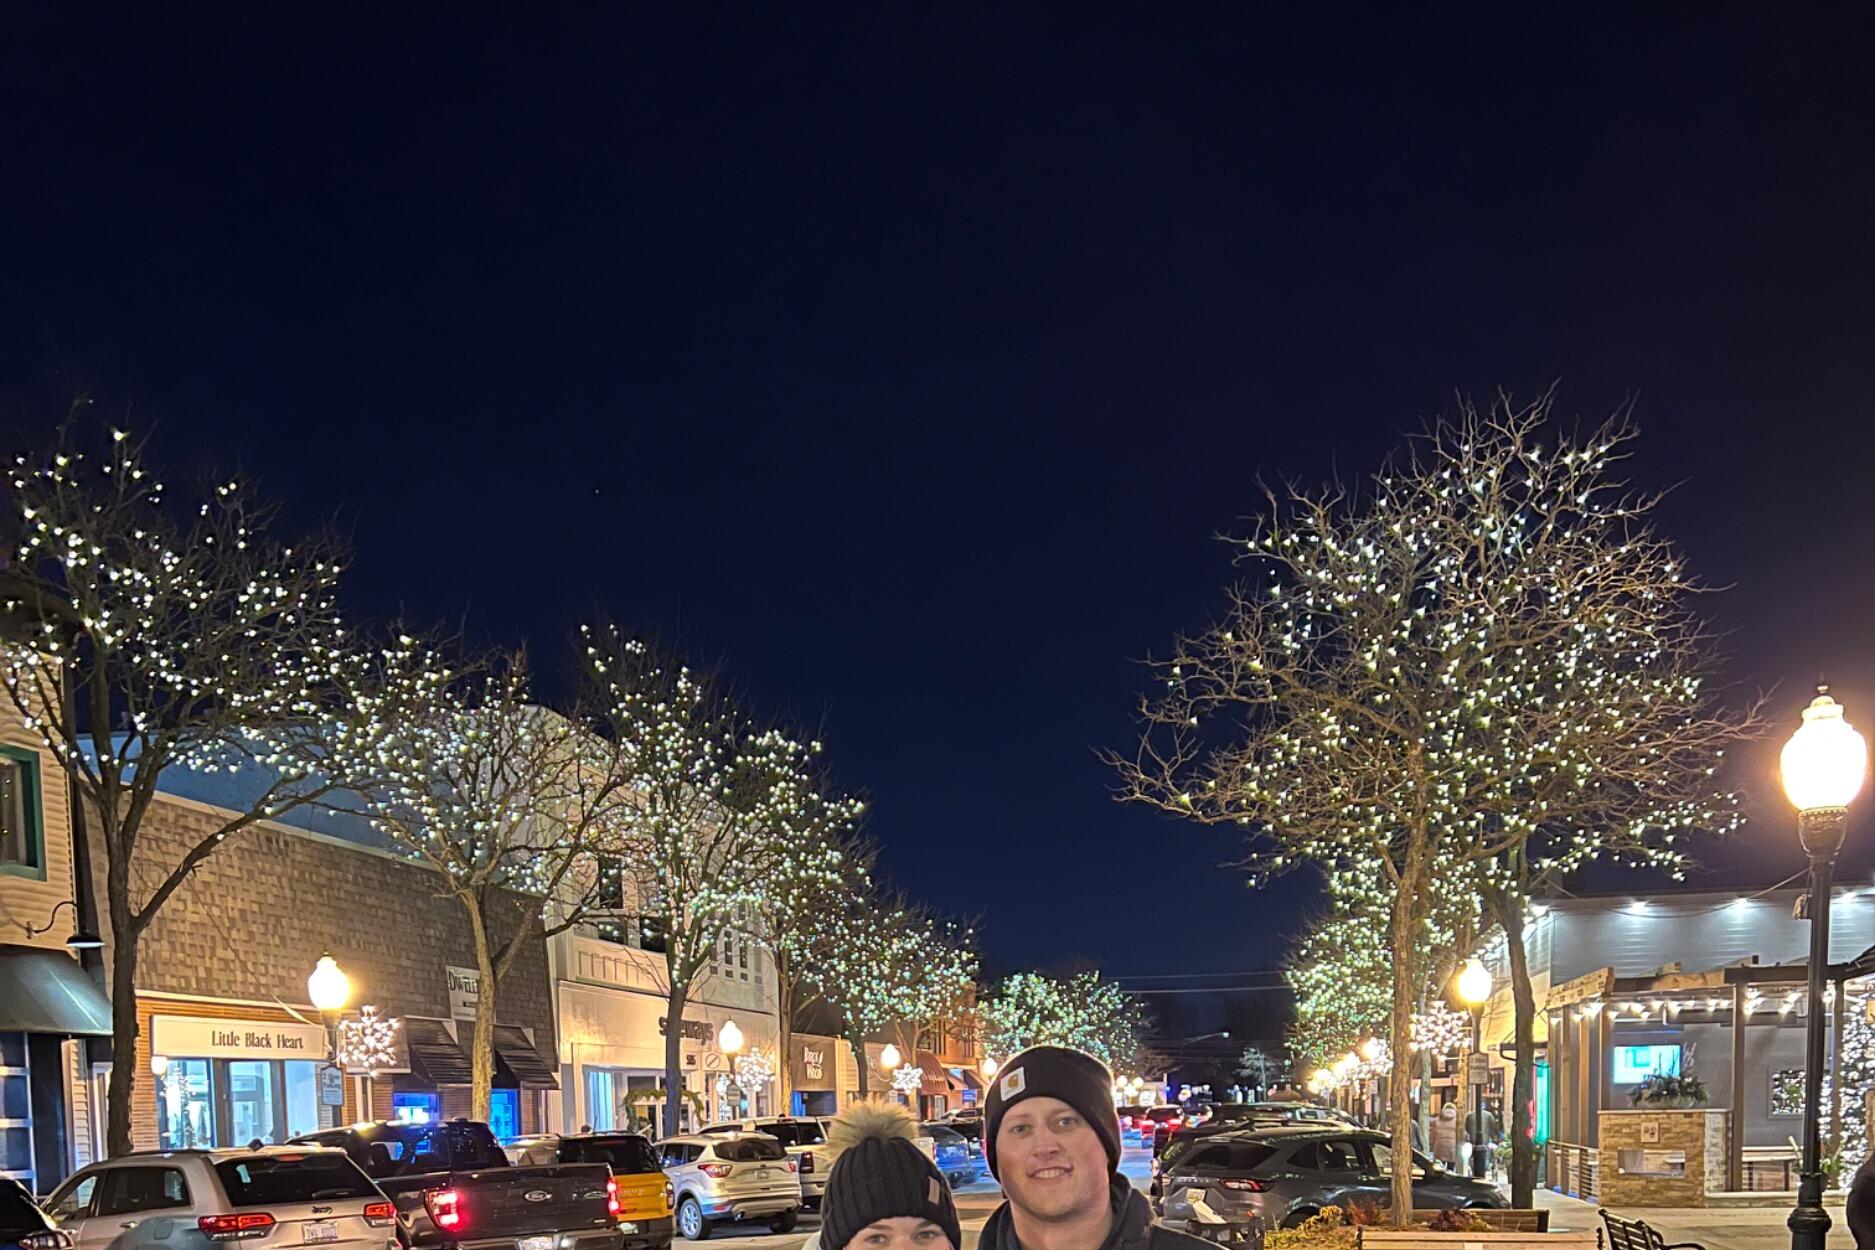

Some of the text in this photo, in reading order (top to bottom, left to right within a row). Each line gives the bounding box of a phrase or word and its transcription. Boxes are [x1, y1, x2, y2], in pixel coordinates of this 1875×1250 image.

[211, 1030, 304, 1050] Little Black Heart
